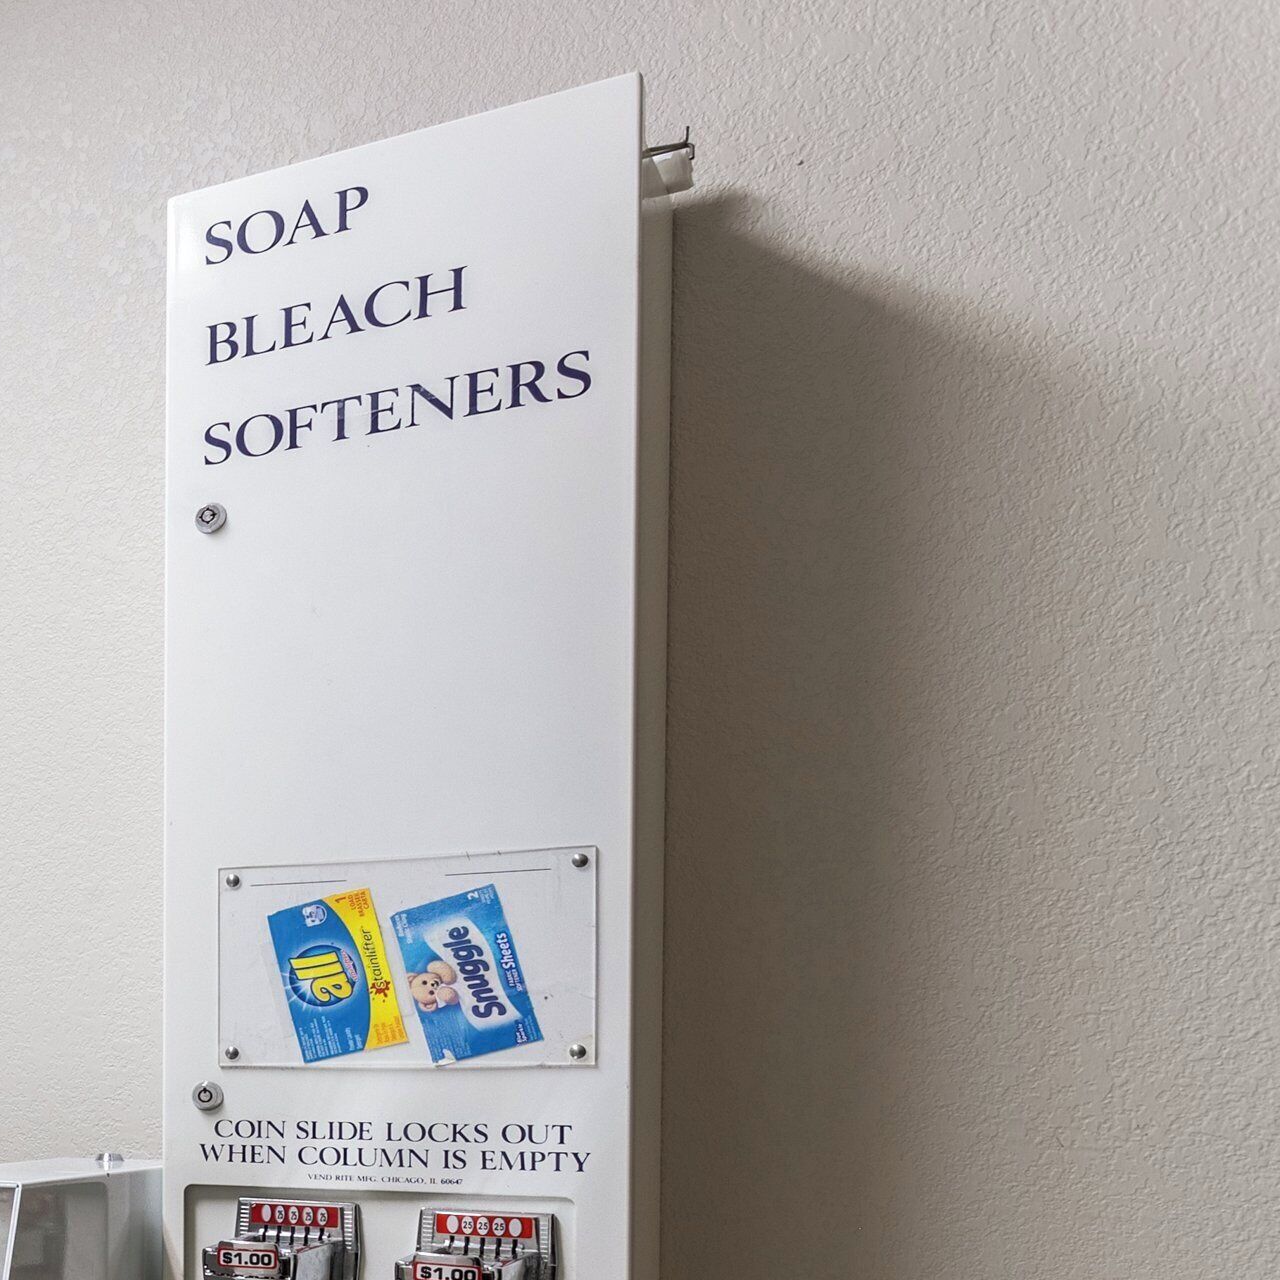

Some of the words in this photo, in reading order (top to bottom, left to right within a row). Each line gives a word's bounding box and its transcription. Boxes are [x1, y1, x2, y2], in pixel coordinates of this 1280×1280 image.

[205, 186, 369, 265] SOAP
[205, 265, 468, 366] BLEACH
[204, 350, 592, 465] SOFTENERS
[362, 928, 386, 989] stainlifter
[496, 932, 516, 969] Sheets
[288, 950, 353, 1002] all
[443, 926, 507, 1018] Snuggle
[505, 970, 515, 987] FABRIC
[213, 1119, 286, 1140] COIN
[296, 1120, 373, 1141] SLIDE
[385, 1122, 489, 1145] LOCKS
[500, 1124, 573, 1145] OUT
[199, 1143, 286, 1165] WHEN
[298, 1145, 430, 1170] COLUMN
[442, 1149, 467, 1170] IS
[480, 1150, 591, 1173] EMPTY
[307, 1173, 333, 1181] VEND
[463, 1221, 473, 1229] 25
[478, 1222, 488, 1230] 25
[493, 1223, 504, 1231] 25
[222, 1252, 272, 1266] $1.00
